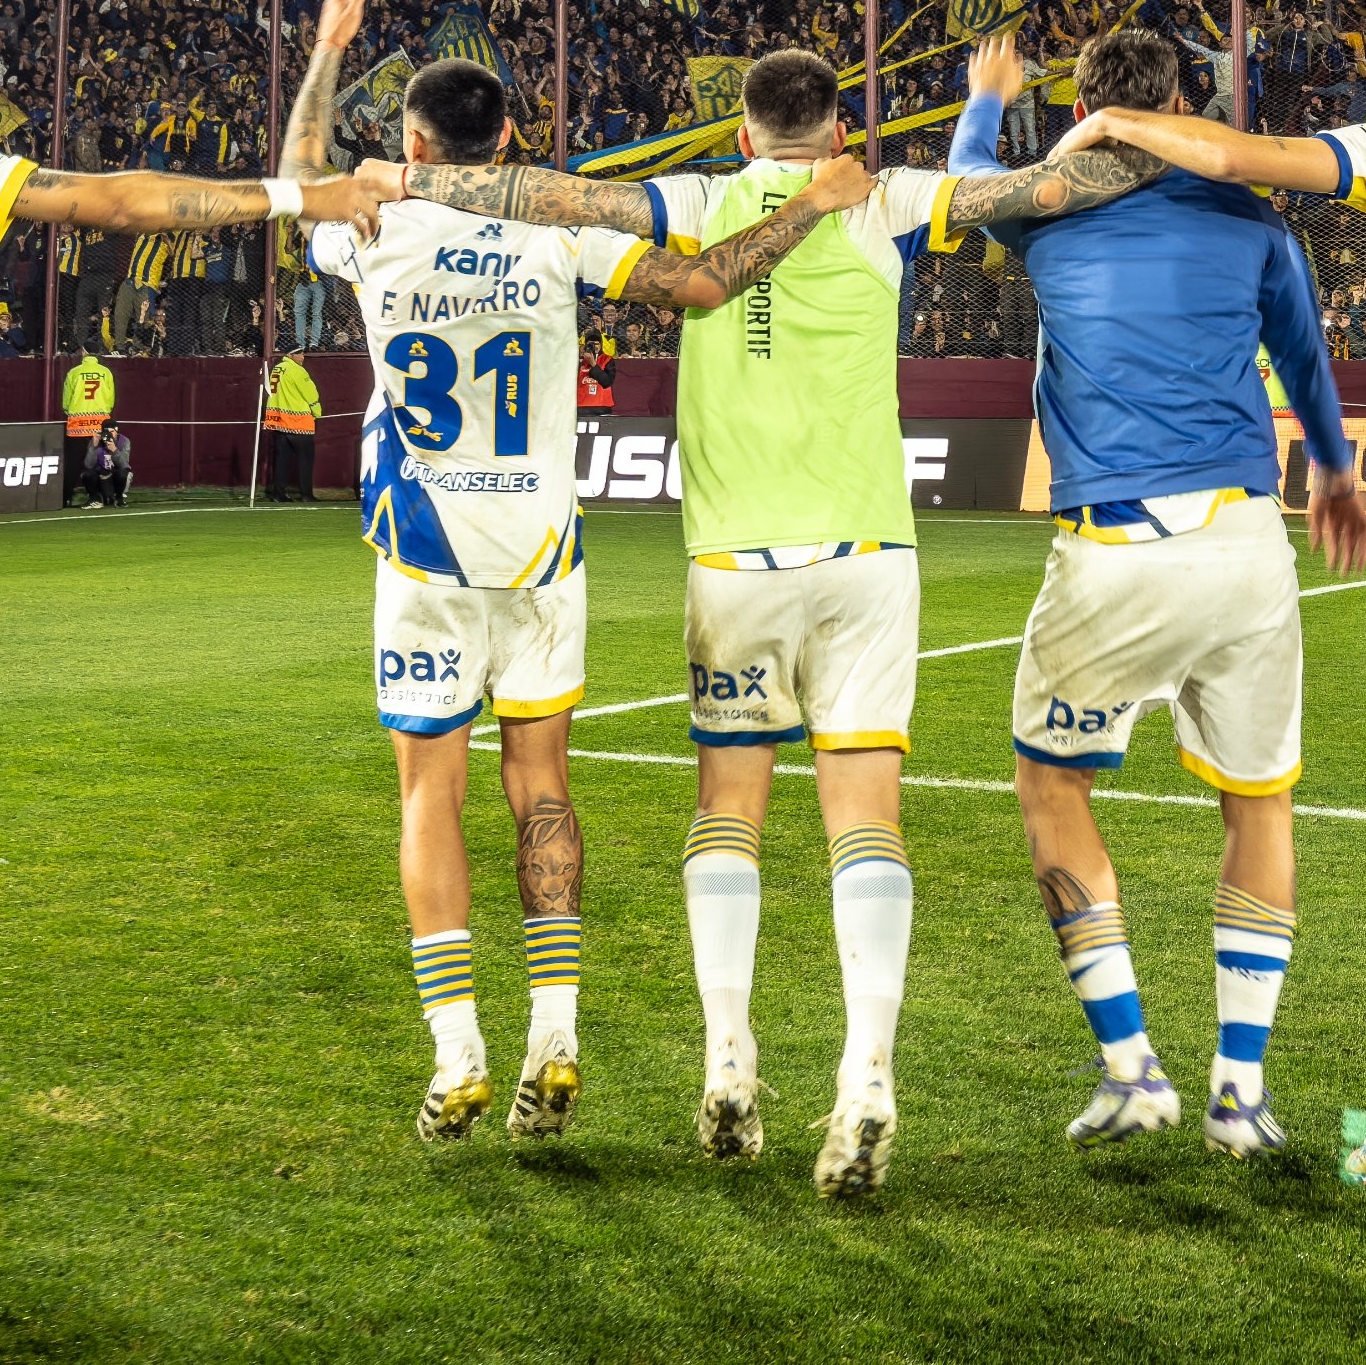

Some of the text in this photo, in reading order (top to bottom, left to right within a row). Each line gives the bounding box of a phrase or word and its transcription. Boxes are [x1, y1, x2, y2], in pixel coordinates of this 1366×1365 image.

[747, 271, 771, 360] PORTIF
[80, 372, 105, 380] TECH
[384, 329, 533, 458] 31
[379, 648, 461, 688] pax
[689, 662, 768, 703] pax
